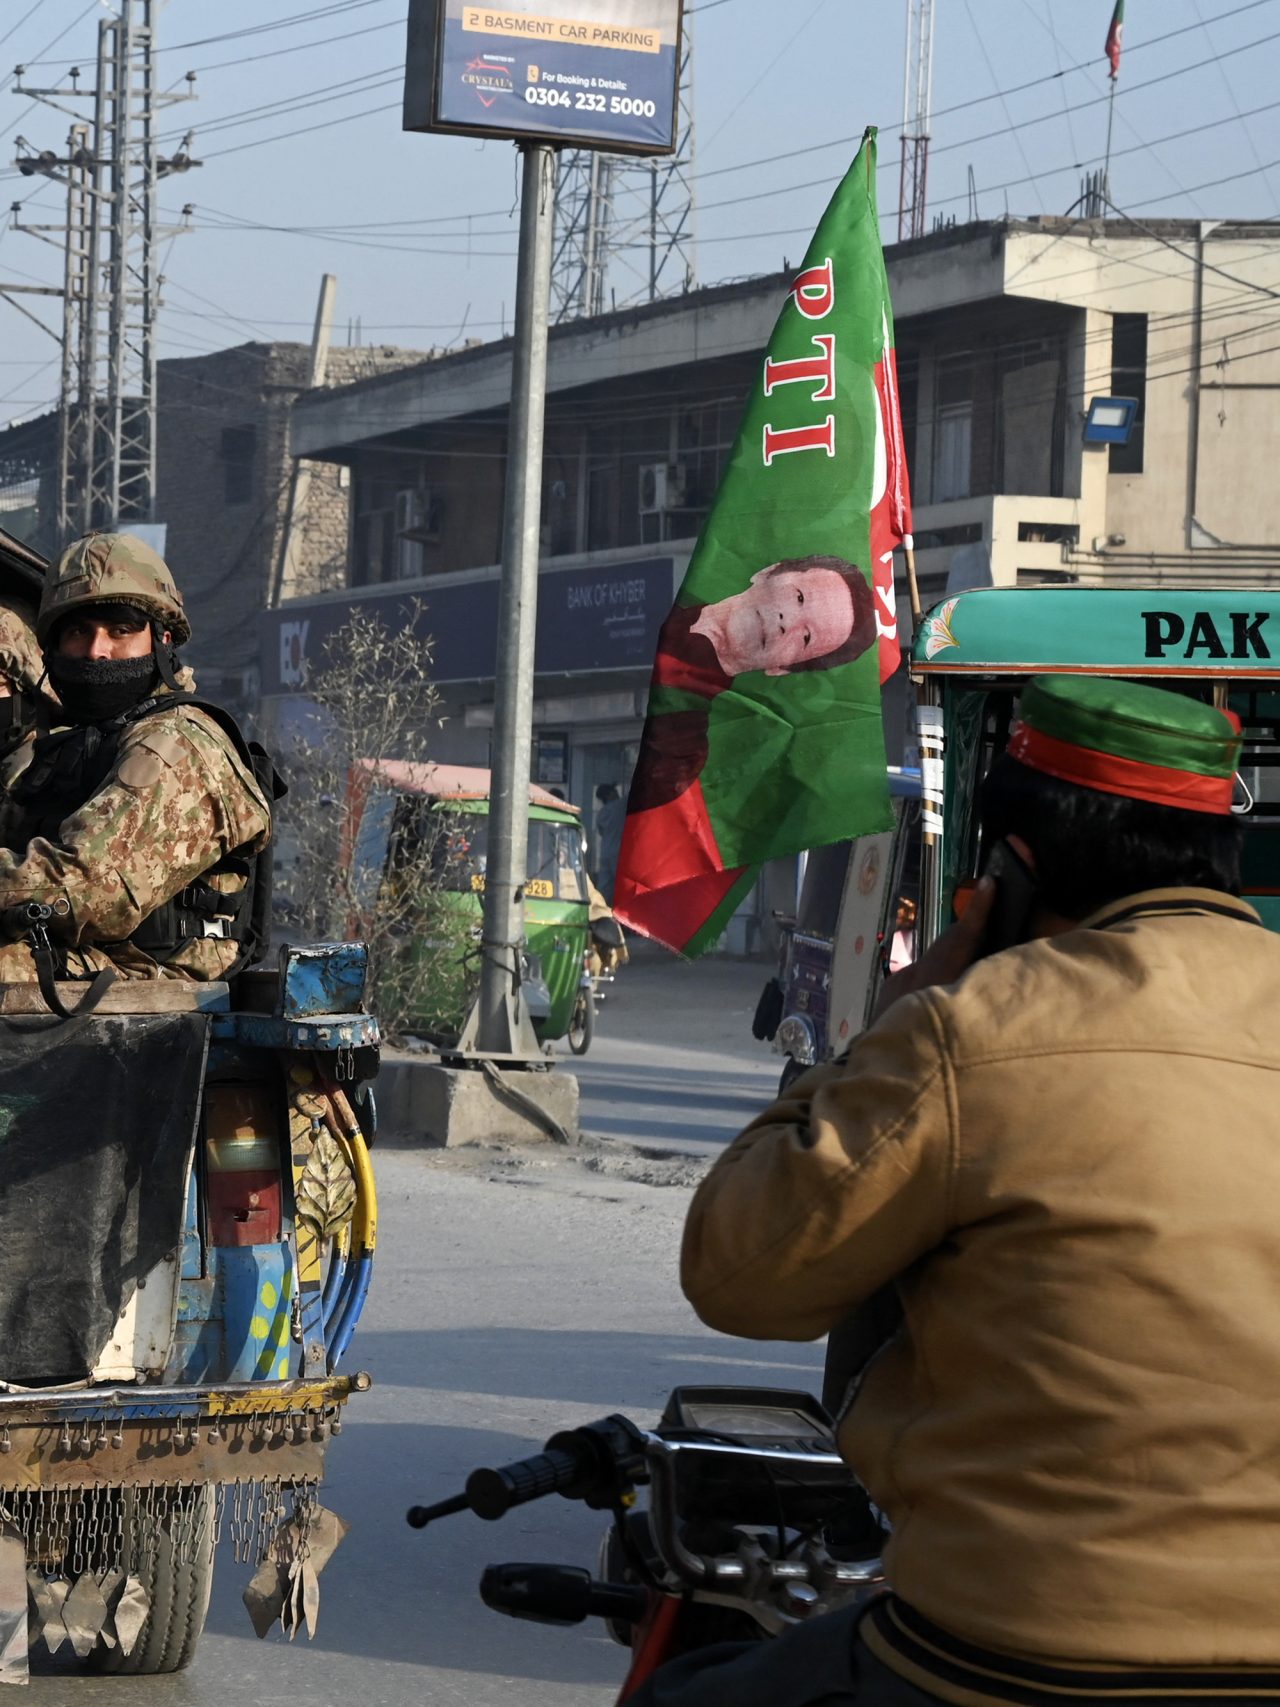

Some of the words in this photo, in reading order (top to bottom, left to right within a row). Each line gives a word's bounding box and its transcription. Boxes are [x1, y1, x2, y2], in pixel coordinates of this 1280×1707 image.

[470, 13, 480, 26] 2
[484, 15, 554, 35] BASMENT
[559, 24, 588, 39] CAR
[592, 27, 654, 47] PARKING
[542, 72, 555, 82] For
[556, 73, 589, 88] Booking
[590, 78, 597, 86] &
[524, 86, 571, 108] 0304
[575, 91, 606, 112] 232
[609, 95, 656, 118] 5000
[763, 257, 836, 467] PTI
[568, 586, 593, 608] BANK
[594, 583, 608, 607] OF
[609, 579, 646, 604] KHYBER
[1141, 611, 1271, 659] PAK
